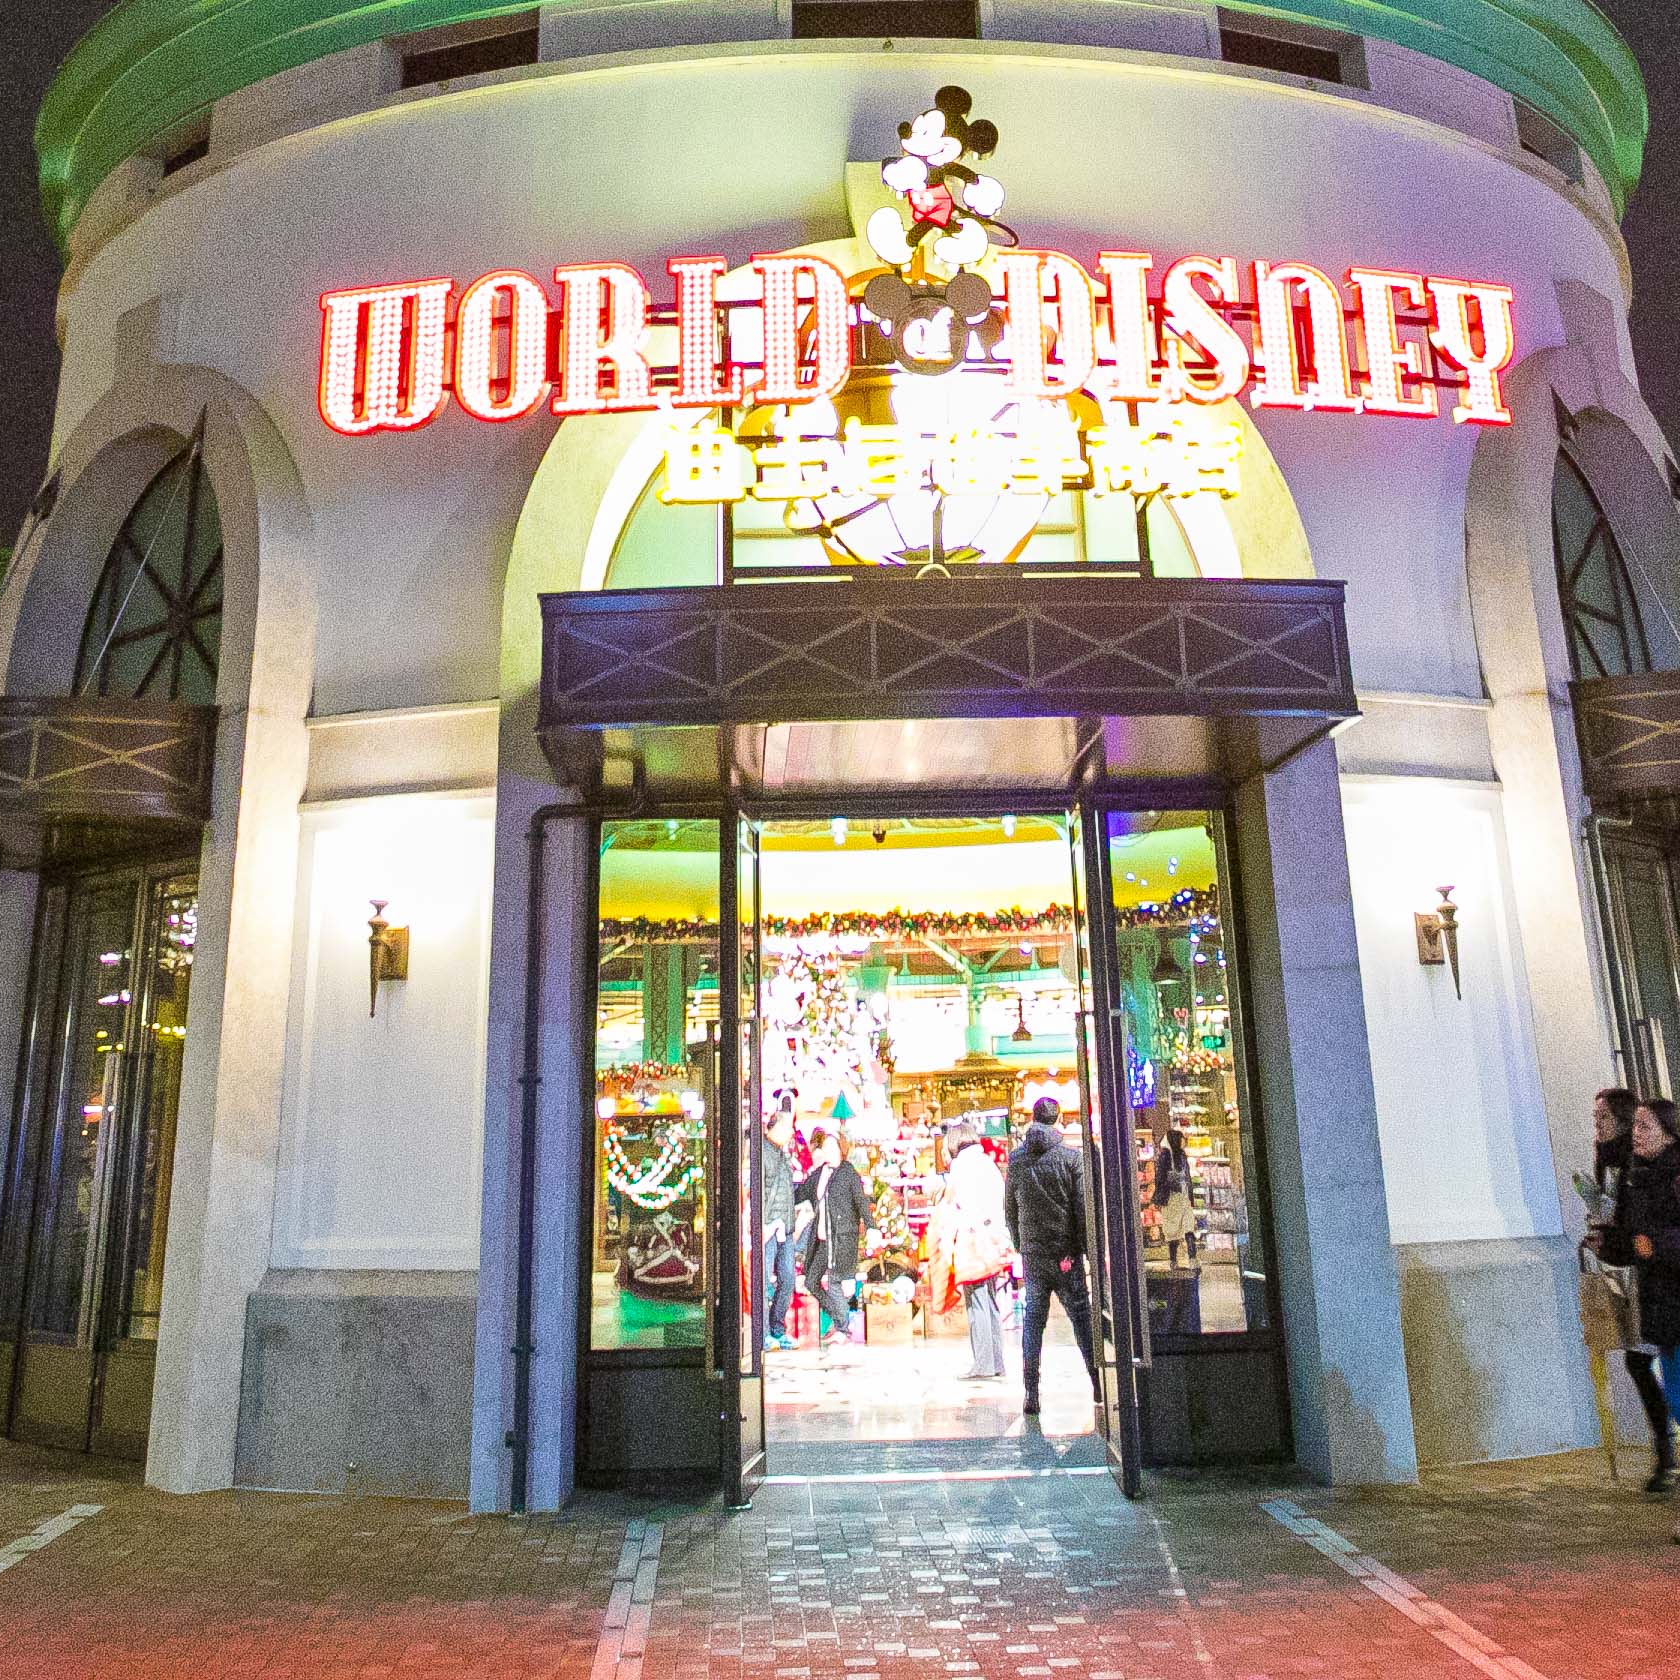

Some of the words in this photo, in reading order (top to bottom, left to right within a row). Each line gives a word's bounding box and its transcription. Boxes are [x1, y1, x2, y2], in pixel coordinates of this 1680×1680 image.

[319, 252, 852, 436] WORLD
[903, 306, 954, 362] of
[994, 247, 1514, 426] DISNEY
